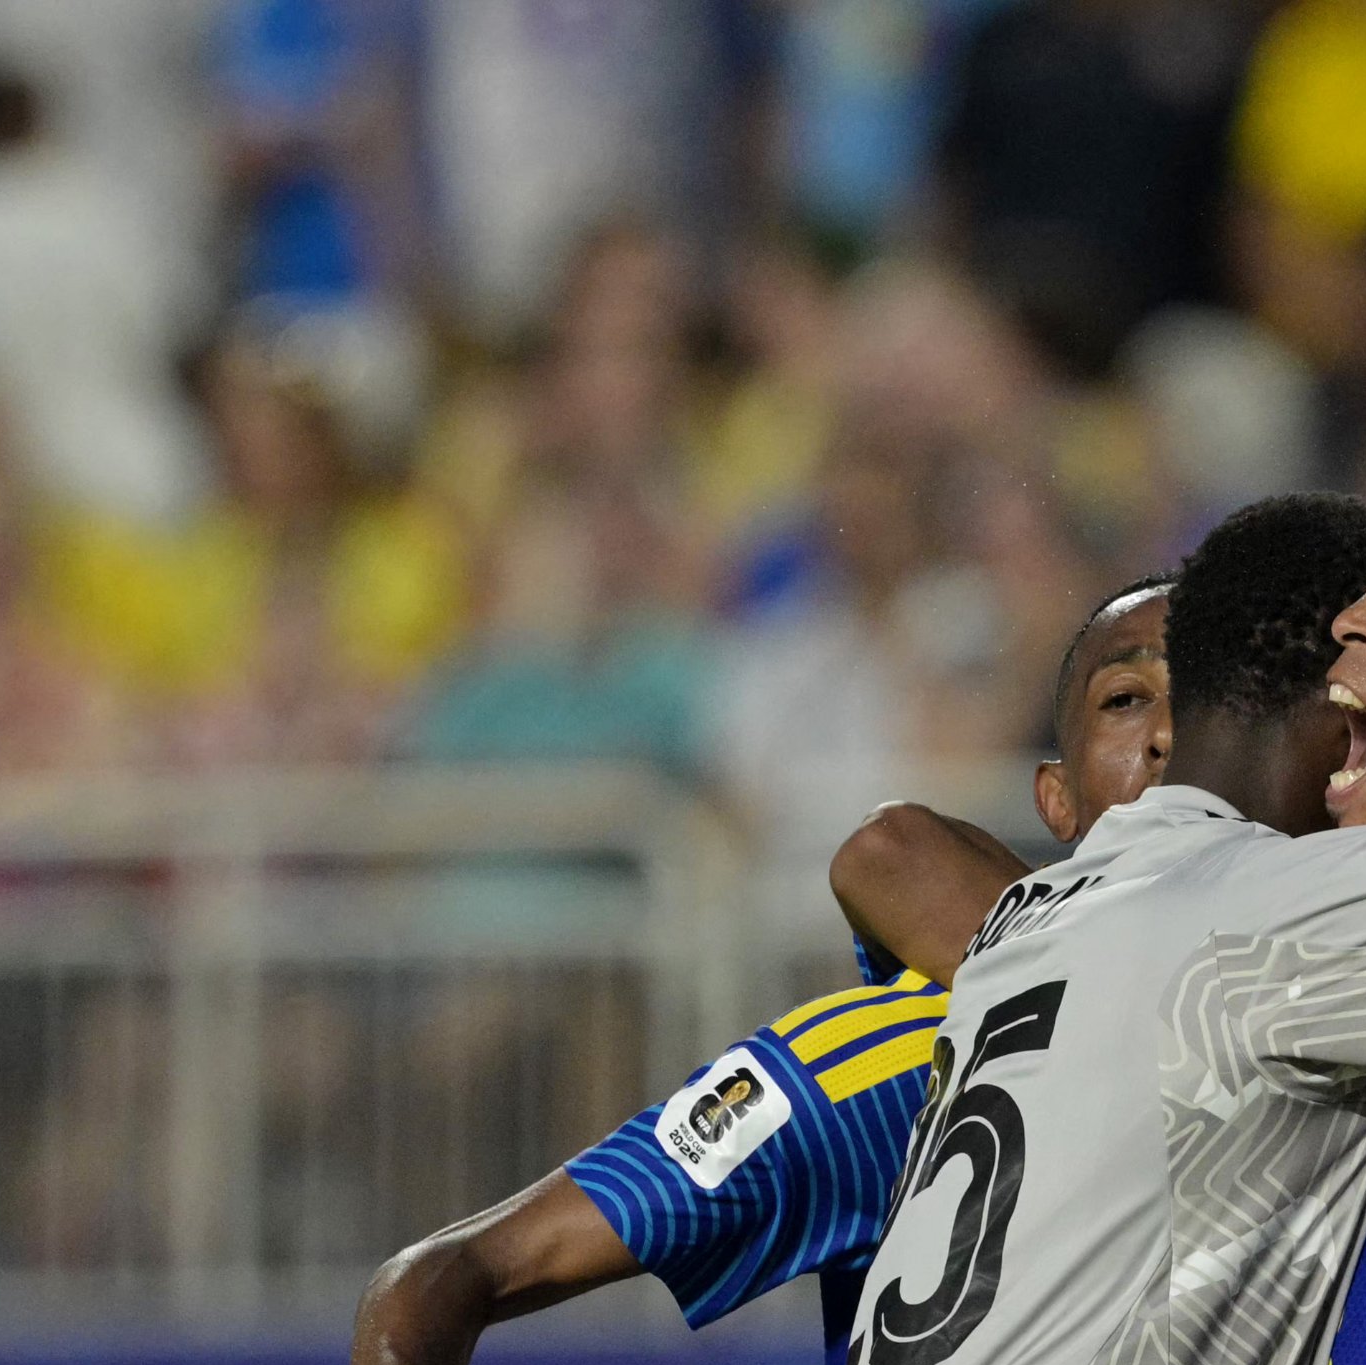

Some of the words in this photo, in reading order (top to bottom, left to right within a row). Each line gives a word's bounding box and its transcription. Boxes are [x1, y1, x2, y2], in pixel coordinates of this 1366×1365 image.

[679, 1121, 694, 1142] WORLD
[692, 1140, 706, 1156] CUP
[696, 1115, 712, 1135] FIFA
[669, 1129, 701, 1165] 2026
